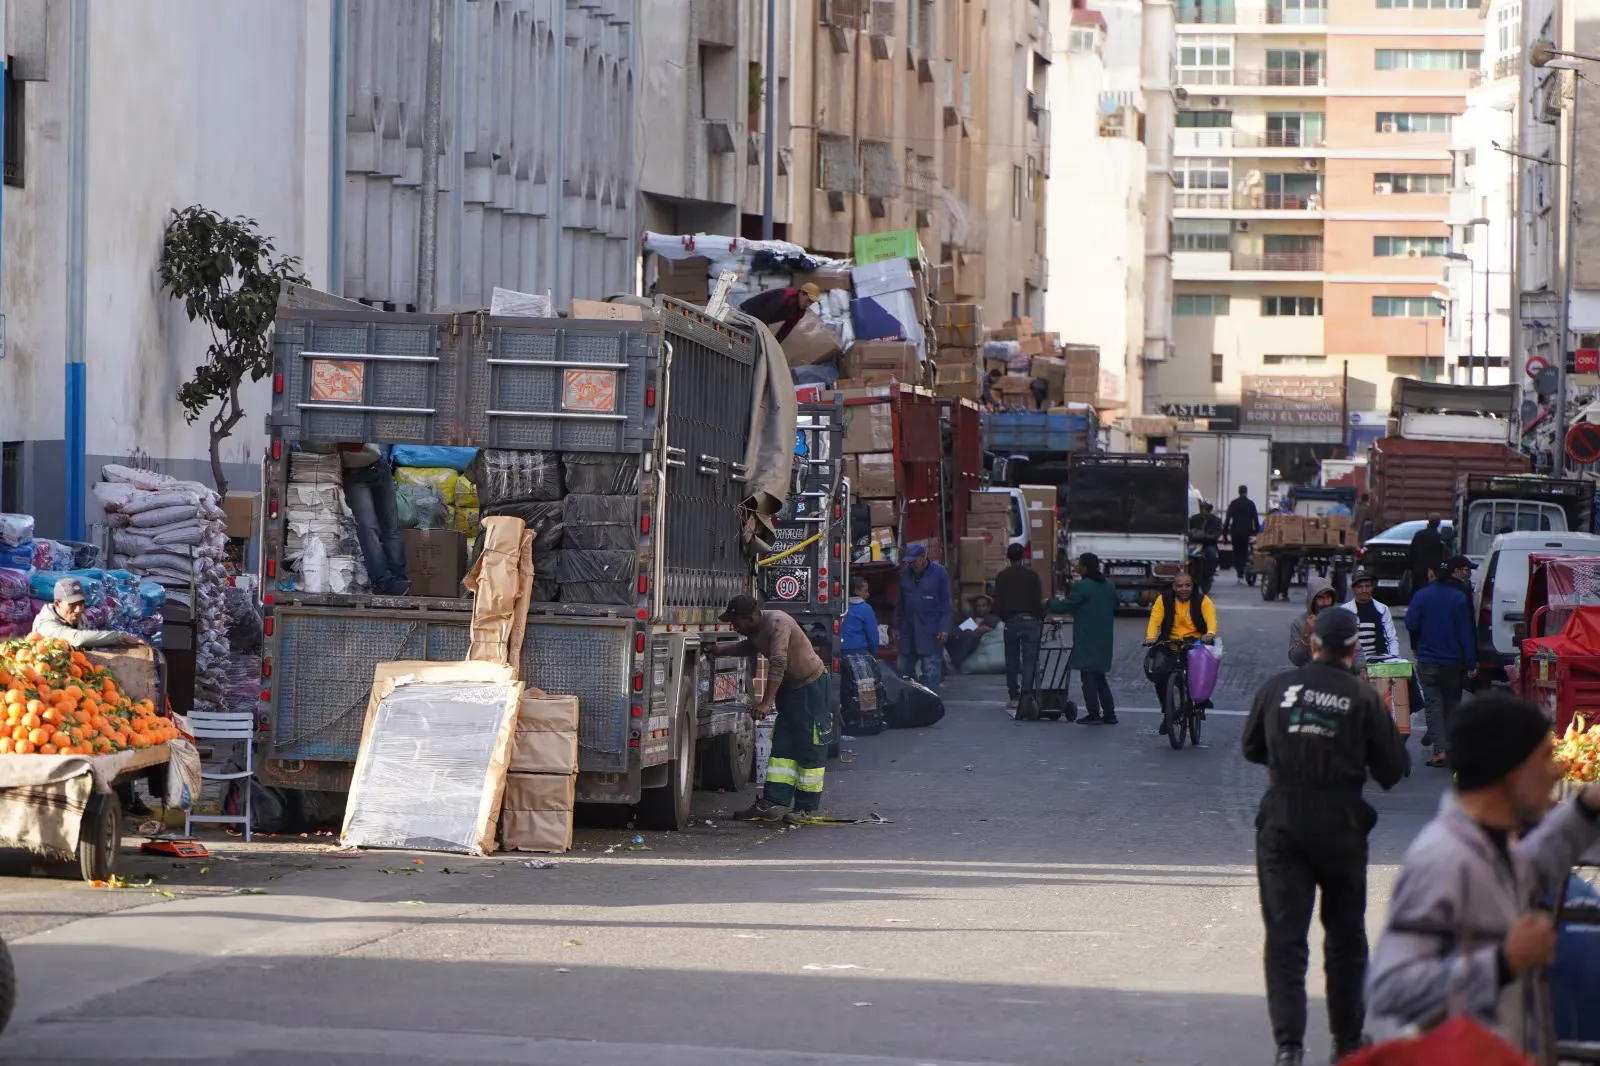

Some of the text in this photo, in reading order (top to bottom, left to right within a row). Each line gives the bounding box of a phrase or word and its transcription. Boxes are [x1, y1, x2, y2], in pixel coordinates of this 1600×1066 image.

[1577, 356, 1597, 365] deli
[1280, 411, 1293, 422] EL
[1298, 411, 1340, 422] YACOUT
[780, 581, 795, 595] 90
[1303, 689, 1351, 710] SWAG
